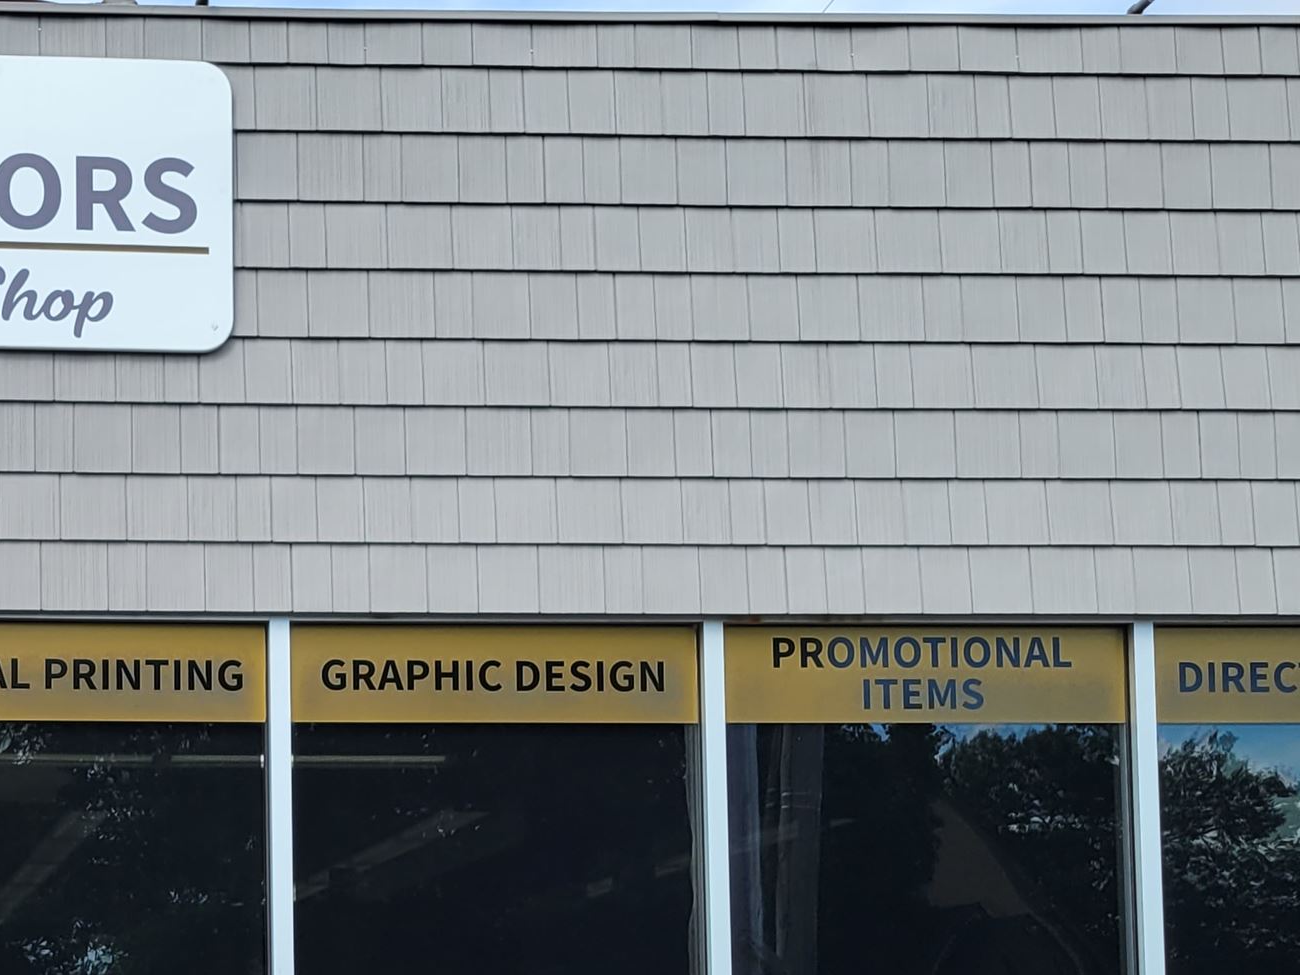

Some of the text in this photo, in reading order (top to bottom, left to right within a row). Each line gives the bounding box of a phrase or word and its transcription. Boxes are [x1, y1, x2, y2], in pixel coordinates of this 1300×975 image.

[771, 635, 1073, 669] PROMOTIONAL
[44, 658, 244, 692] PRINTING
[321, 659, 665, 693] GRAPHIC DESIGN
[1178, 661, 1300, 694] DIREC
[862, 678, 984, 711] ITEMS
